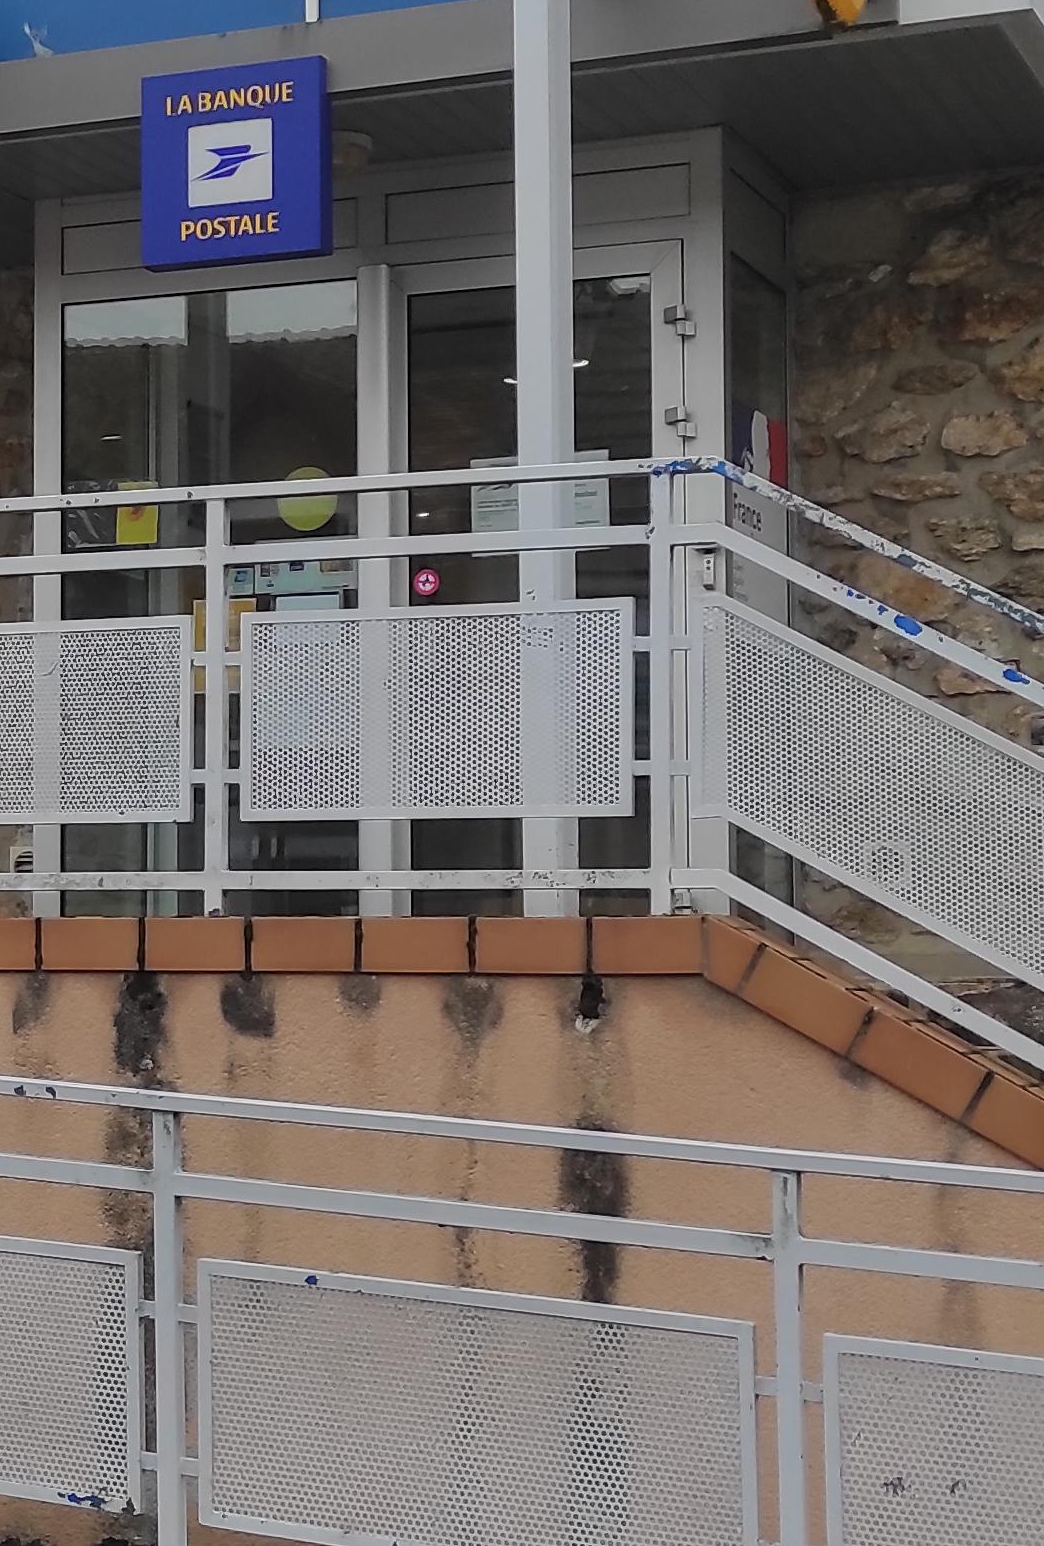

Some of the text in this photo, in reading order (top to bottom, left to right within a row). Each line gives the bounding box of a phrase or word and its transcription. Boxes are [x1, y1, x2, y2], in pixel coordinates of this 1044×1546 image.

[166, 81, 294, 117] LA BANQUE
[180, 211, 280, 242] POSTALE
